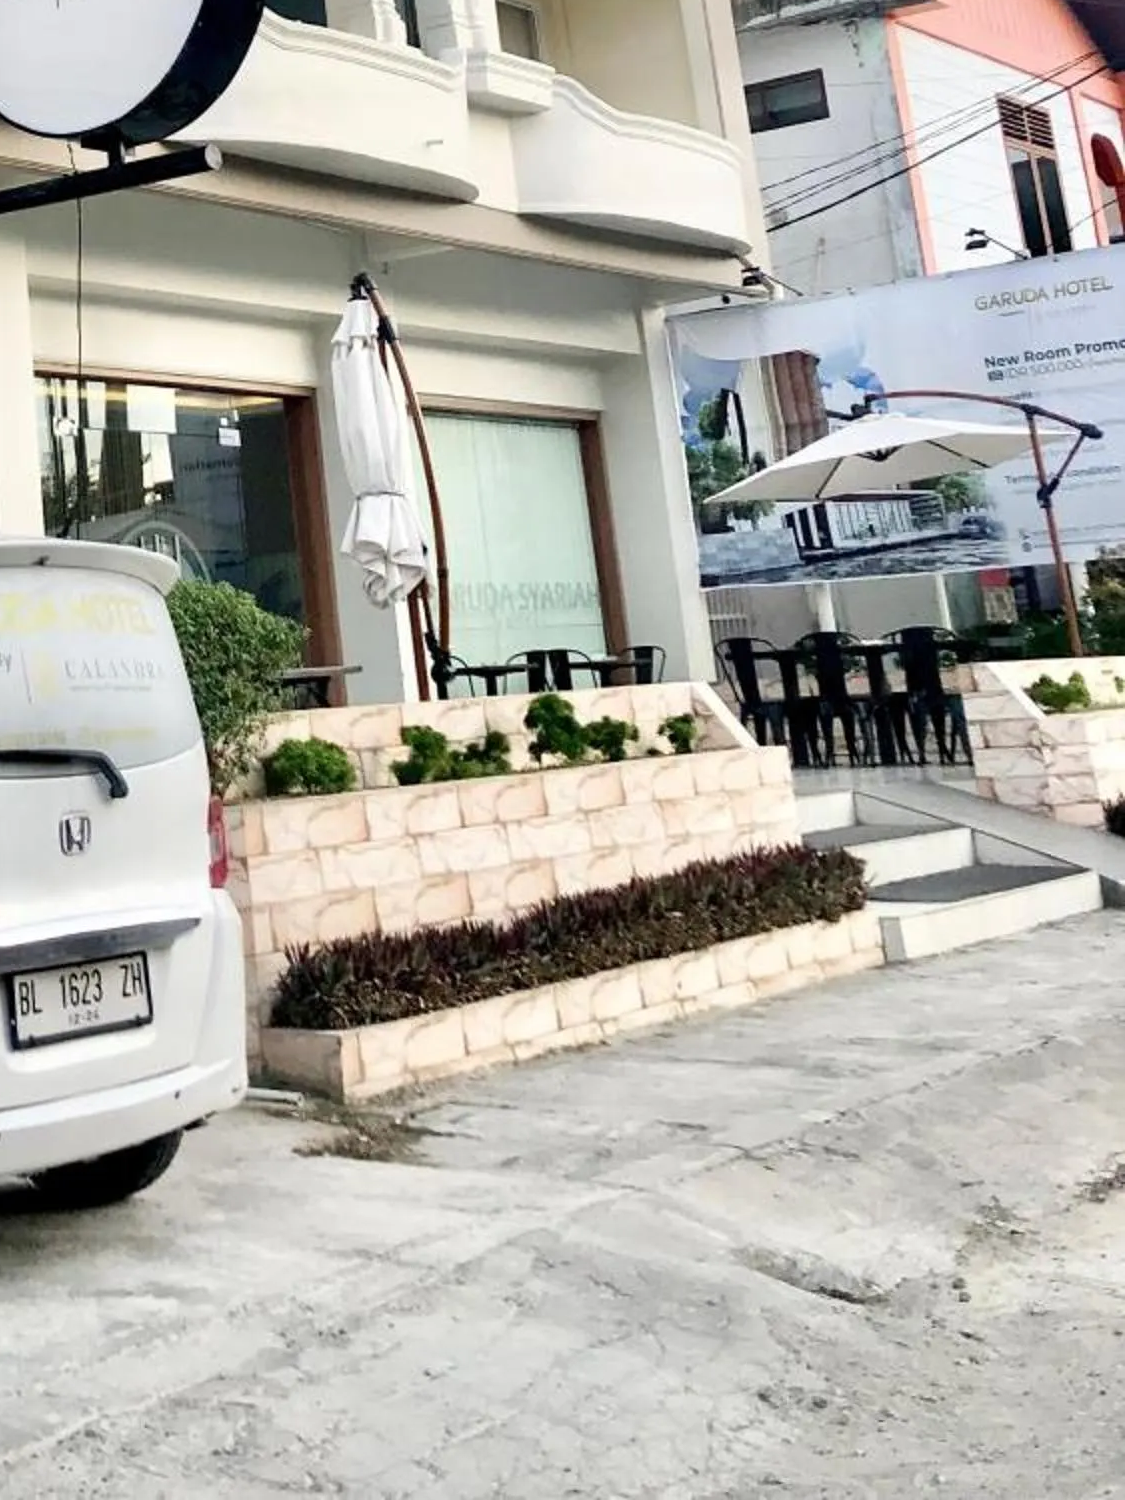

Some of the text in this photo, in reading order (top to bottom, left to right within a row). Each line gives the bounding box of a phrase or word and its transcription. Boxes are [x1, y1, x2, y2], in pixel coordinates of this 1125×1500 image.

[975, 286, 1049, 311] GARUDA
[1054, 276, 1113, 298] HOTEL
[985, 356, 1019, 368] New
[1024, 347, 1071, 362] Room
[19, 962, 143, 1015] BL 1623 ZH
